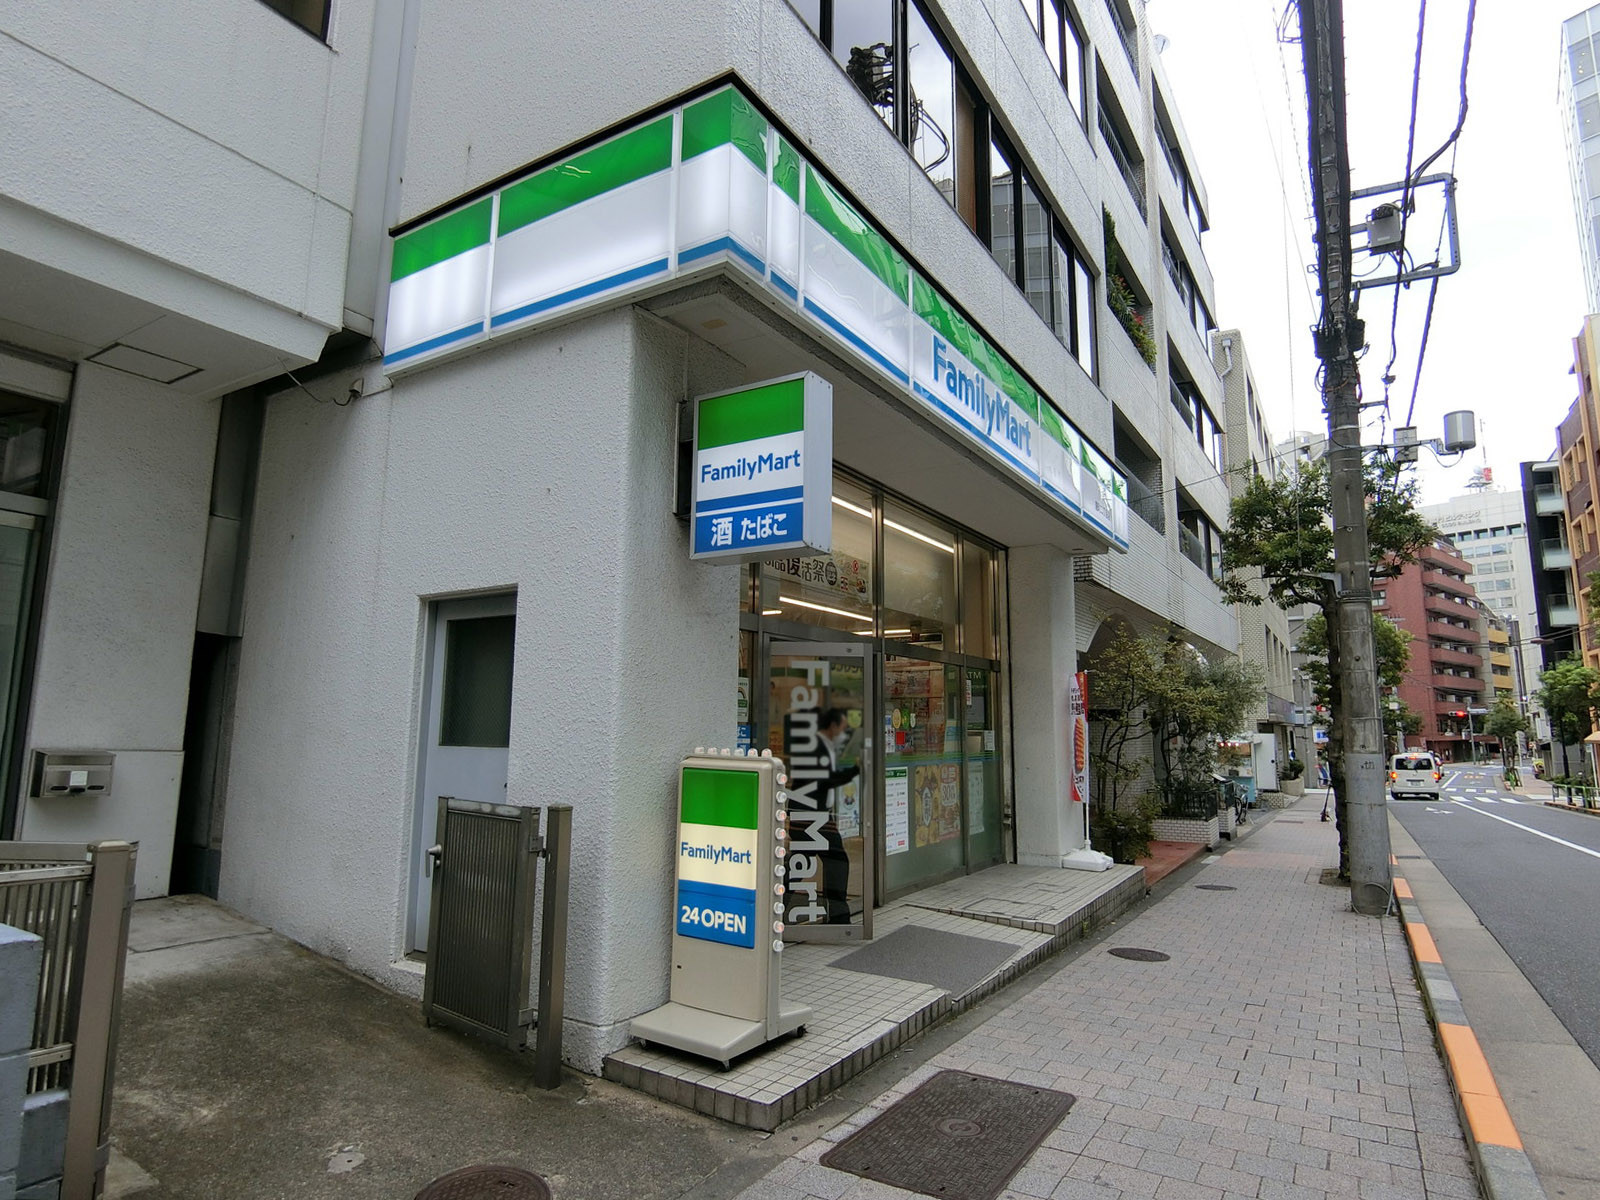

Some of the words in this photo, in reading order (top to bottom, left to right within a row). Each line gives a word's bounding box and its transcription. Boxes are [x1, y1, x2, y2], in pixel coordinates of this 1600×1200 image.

[933, 334, 1031, 457] FamilyMart
[701, 450, 800, 483] FamilyMart
[711, 516, 733, 546] 酒
[740, 513, 787, 540] たばこ
[785, 660, 830, 923] FamilyMart
[681, 842, 752, 865] FamilyMart
